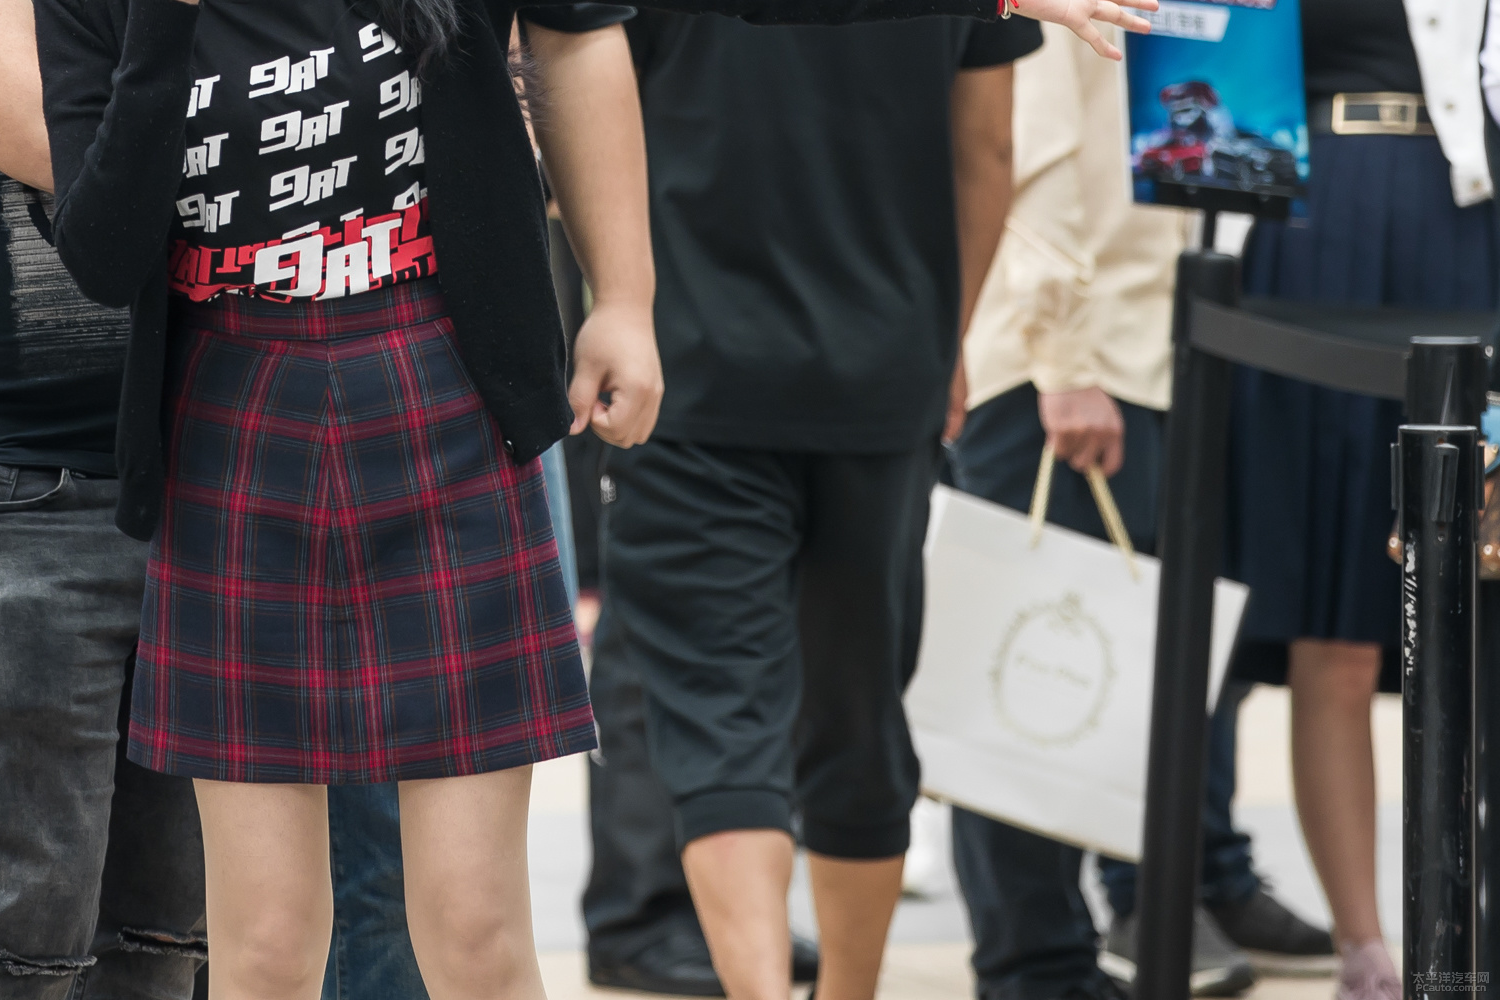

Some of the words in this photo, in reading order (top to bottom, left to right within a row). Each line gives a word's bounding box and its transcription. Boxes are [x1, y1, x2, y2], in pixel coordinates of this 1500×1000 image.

[249, 47, 335, 99] 9AT
[259, 100, 349, 155] 9AT
[182, 132, 230, 178] AT
[269, 156, 357, 212] 9AT
[176, 190, 240, 233] 9AT
[254, 218, 402, 301] 9AT
